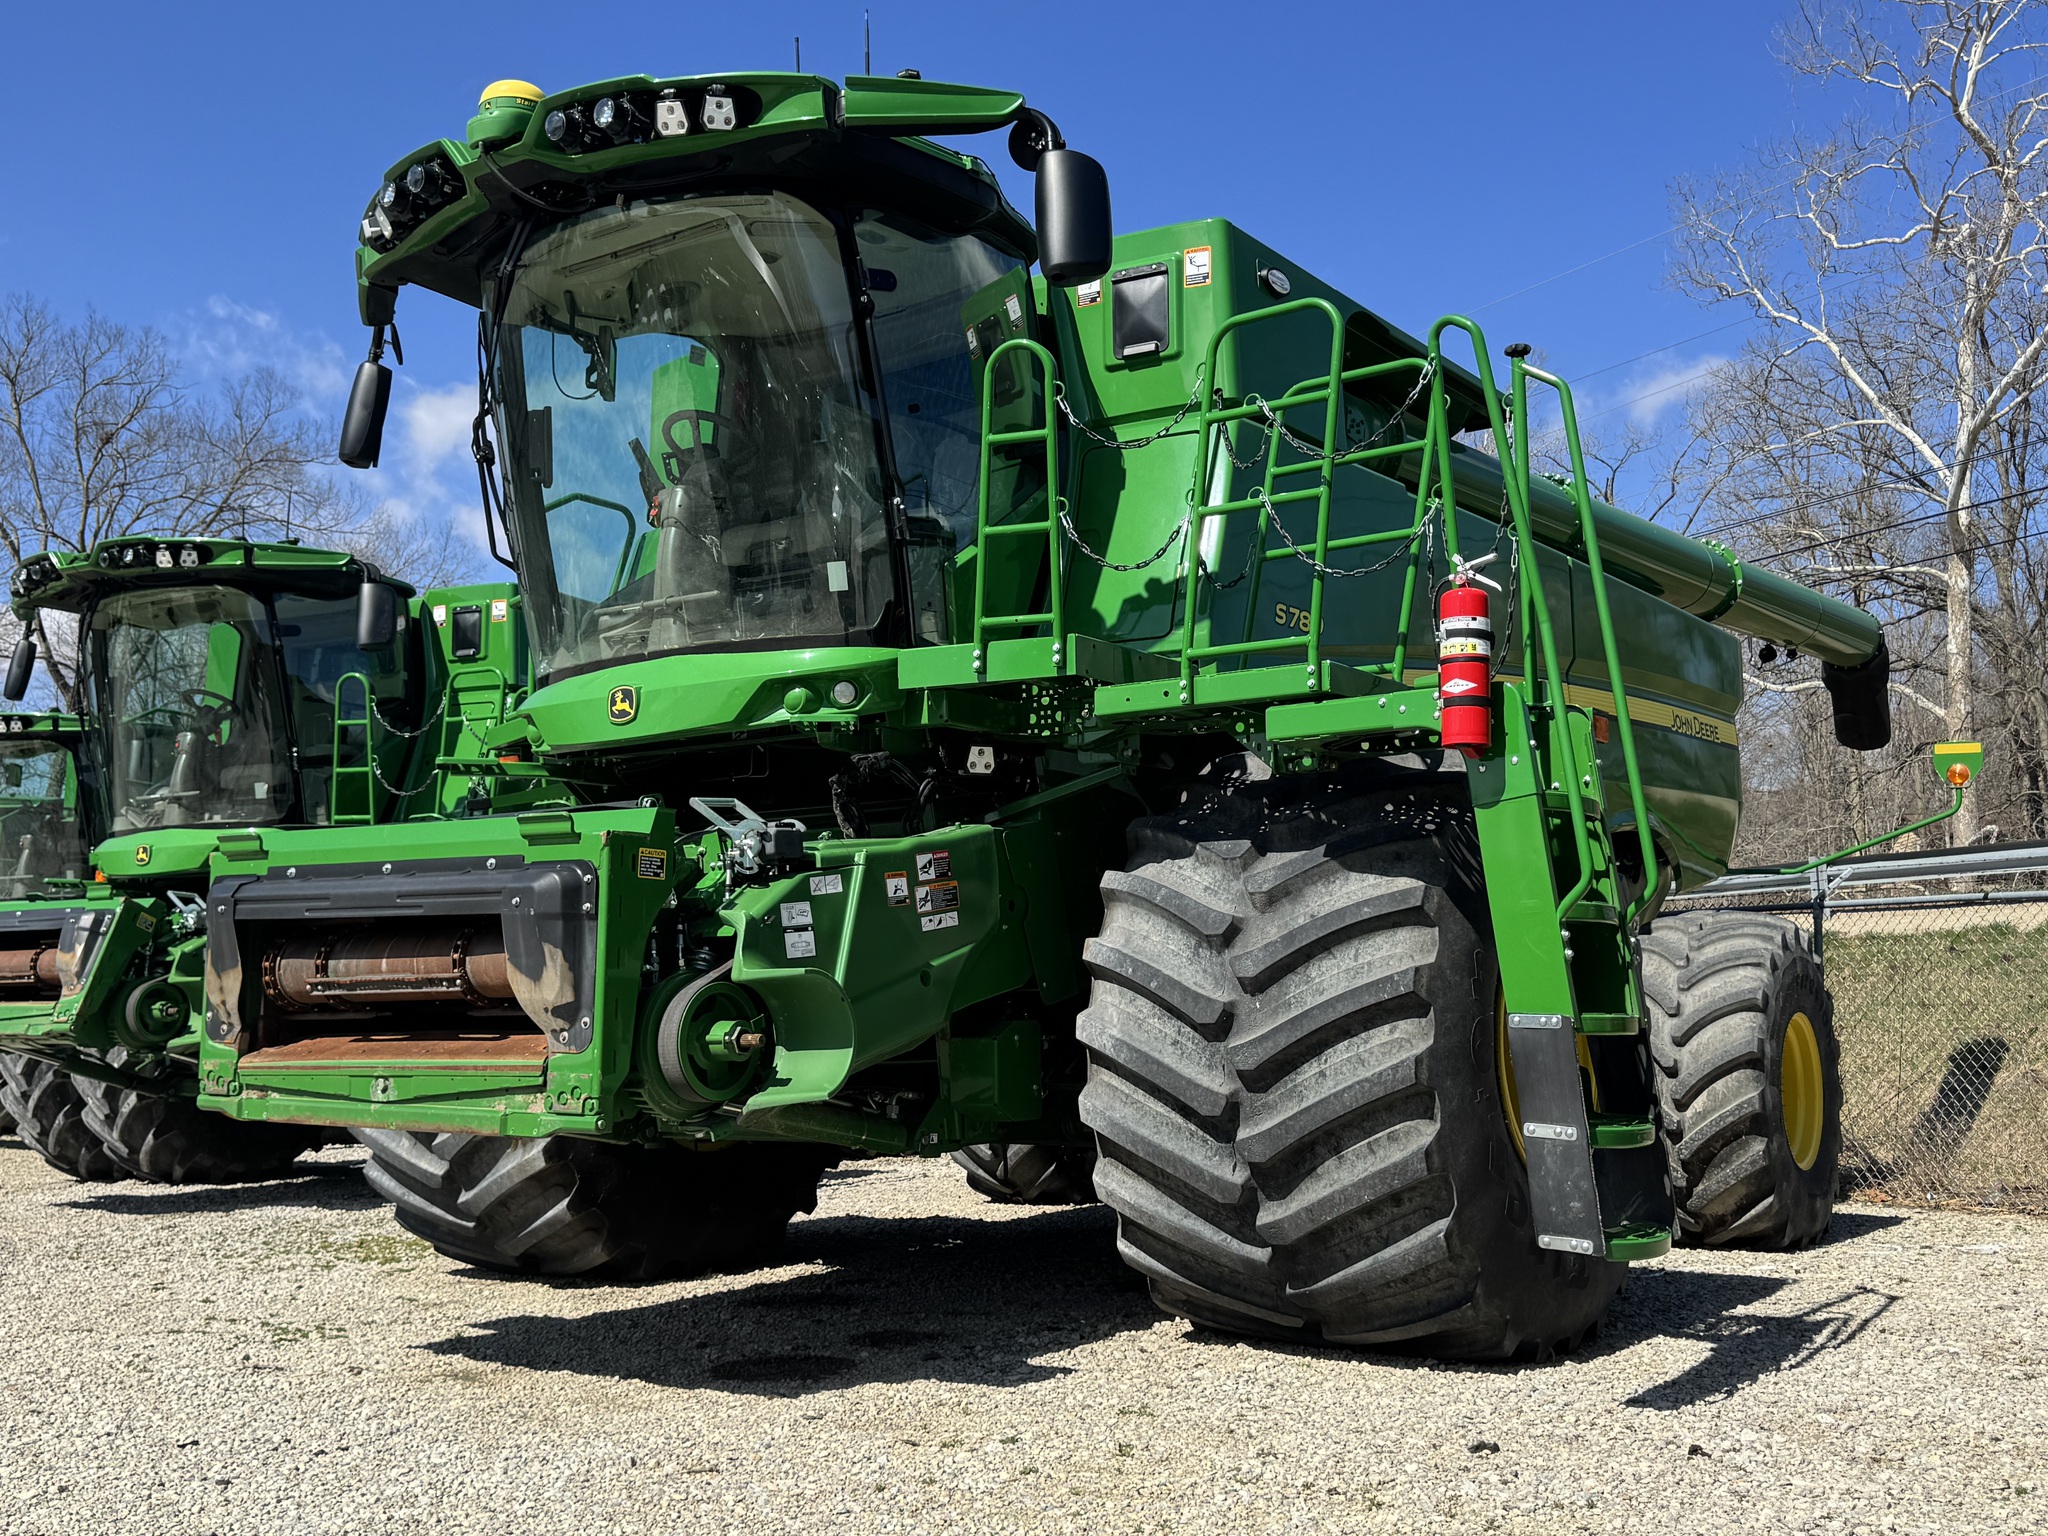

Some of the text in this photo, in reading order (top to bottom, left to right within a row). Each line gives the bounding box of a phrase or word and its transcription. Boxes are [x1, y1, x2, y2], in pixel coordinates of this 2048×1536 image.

[1275, 602, 1324, 635] S78
[1671, 709, 1720, 742] JOHN DEERE
[644, 849, 666, 857] CAUTION
